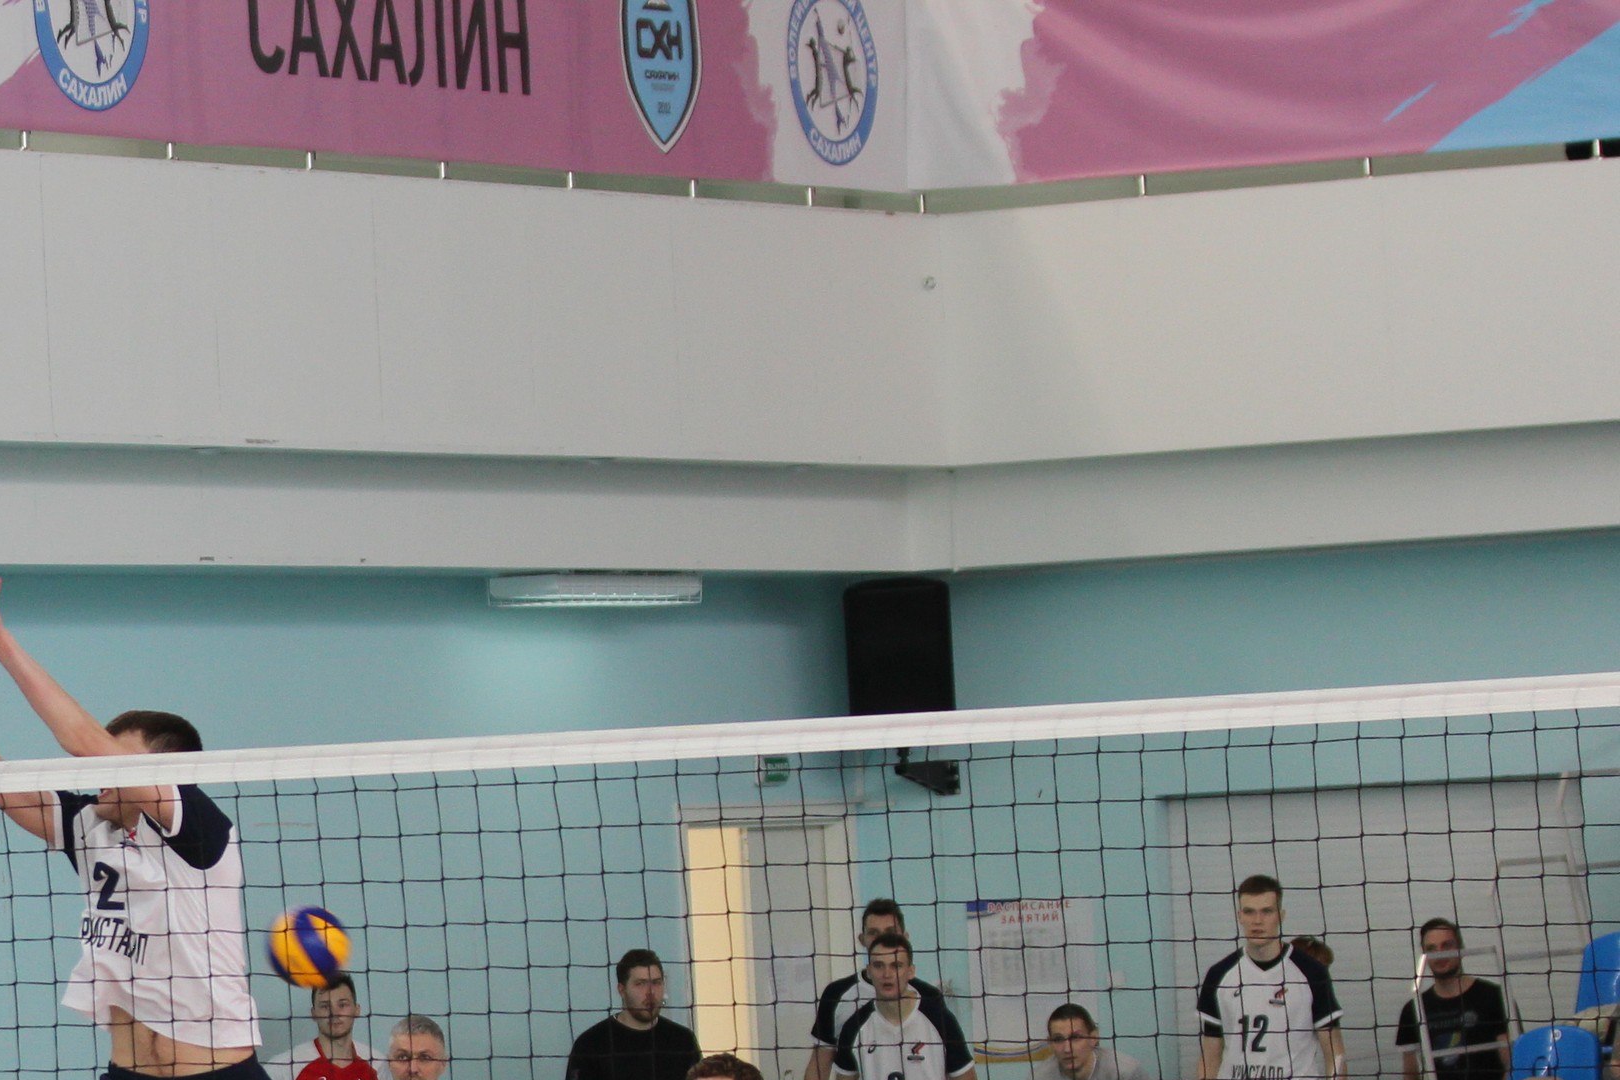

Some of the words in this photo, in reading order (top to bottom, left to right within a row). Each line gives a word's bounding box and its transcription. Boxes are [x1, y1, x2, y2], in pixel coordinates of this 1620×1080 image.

[248, 0, 531, 96] САХАЛИН
[58, 67, 129, 107] САХАЛИН
[810, 127, 863, 162] САХАЛИН
[93, 861, 126, 911] 2
[1238, 1014, 1270, 1053] 12
